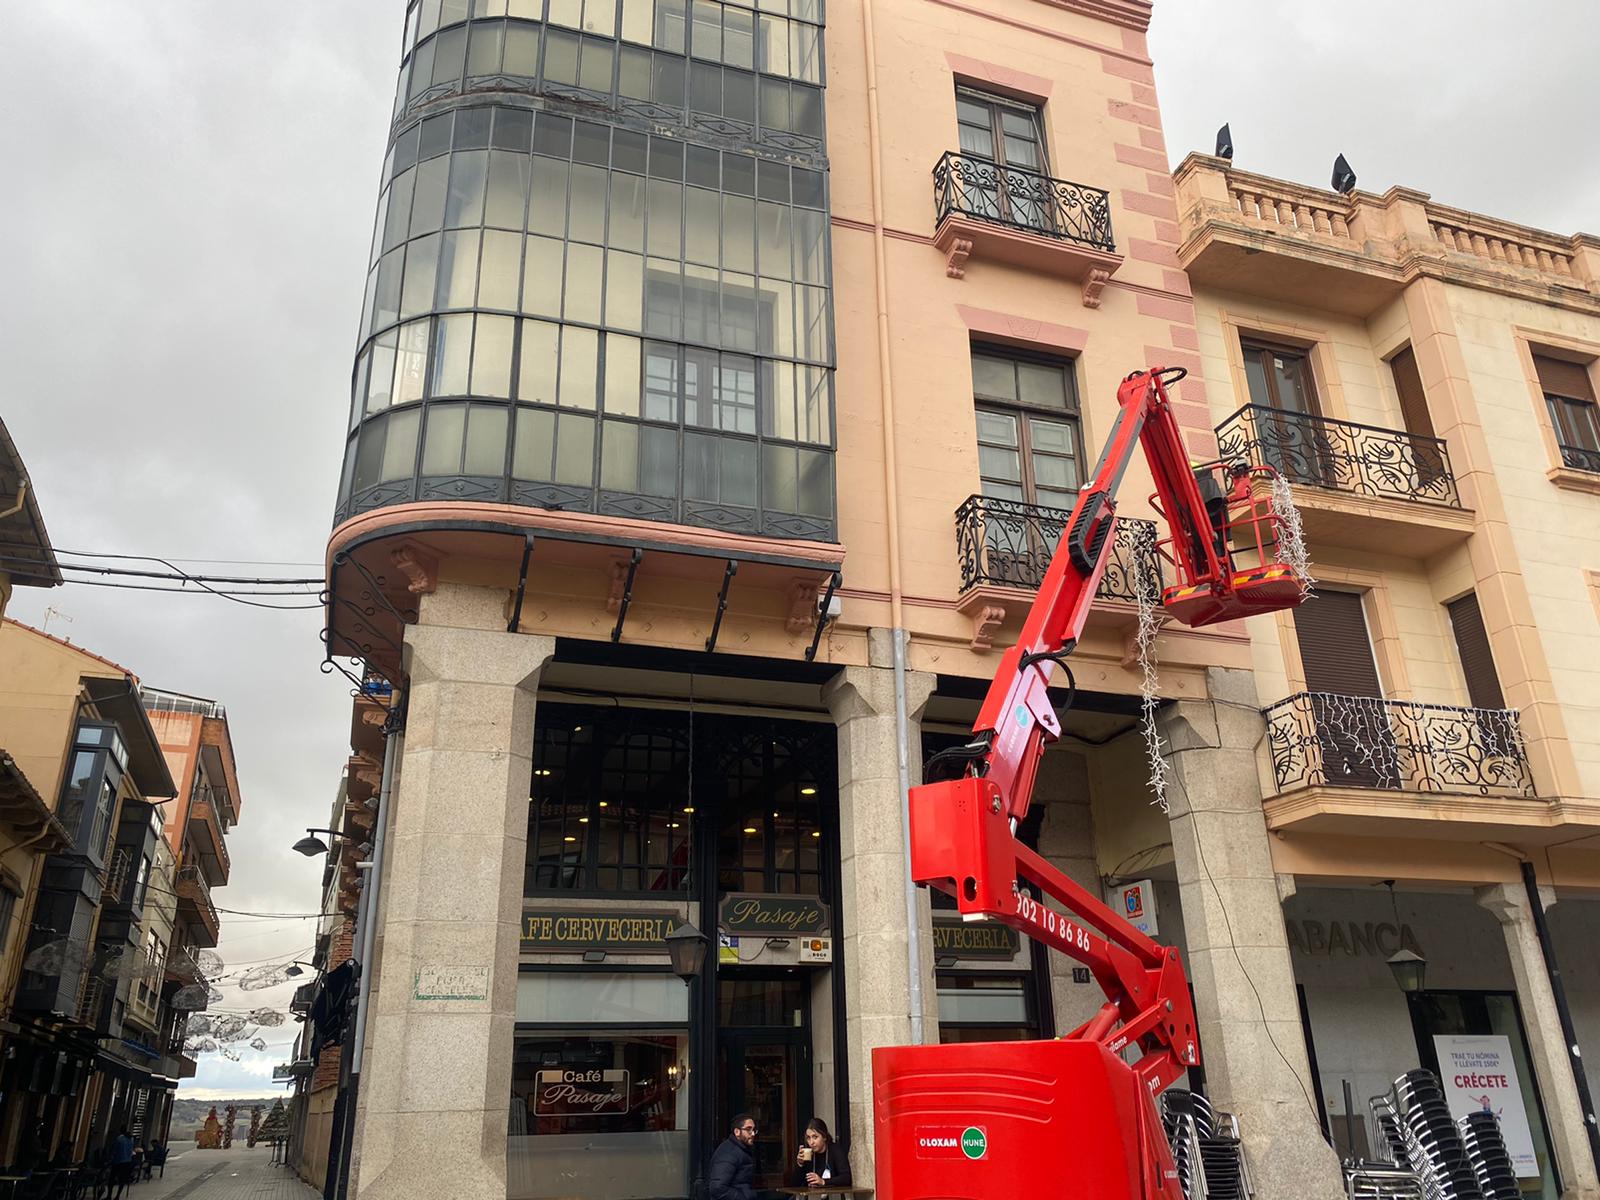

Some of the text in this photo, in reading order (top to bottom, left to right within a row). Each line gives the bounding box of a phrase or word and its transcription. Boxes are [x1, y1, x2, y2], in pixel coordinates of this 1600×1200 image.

[729, 900, 819, 930] Pasaje
[555, 917, 676, 942] CERVECERIA
[1042, 908, 1056, 933] 10
[1059, 918, 1073, 943] 86
[1077, 927, 1090, 952] 86
[1073, 969, 1088, 981] 14
[563, 1070, 601, 1083] Café
[1454, 1072, 1509, 1088] CRÉCETE
[541, 1084, 624, 1112] Pasaje
[963, 1138, 985, 1148] HUNE
